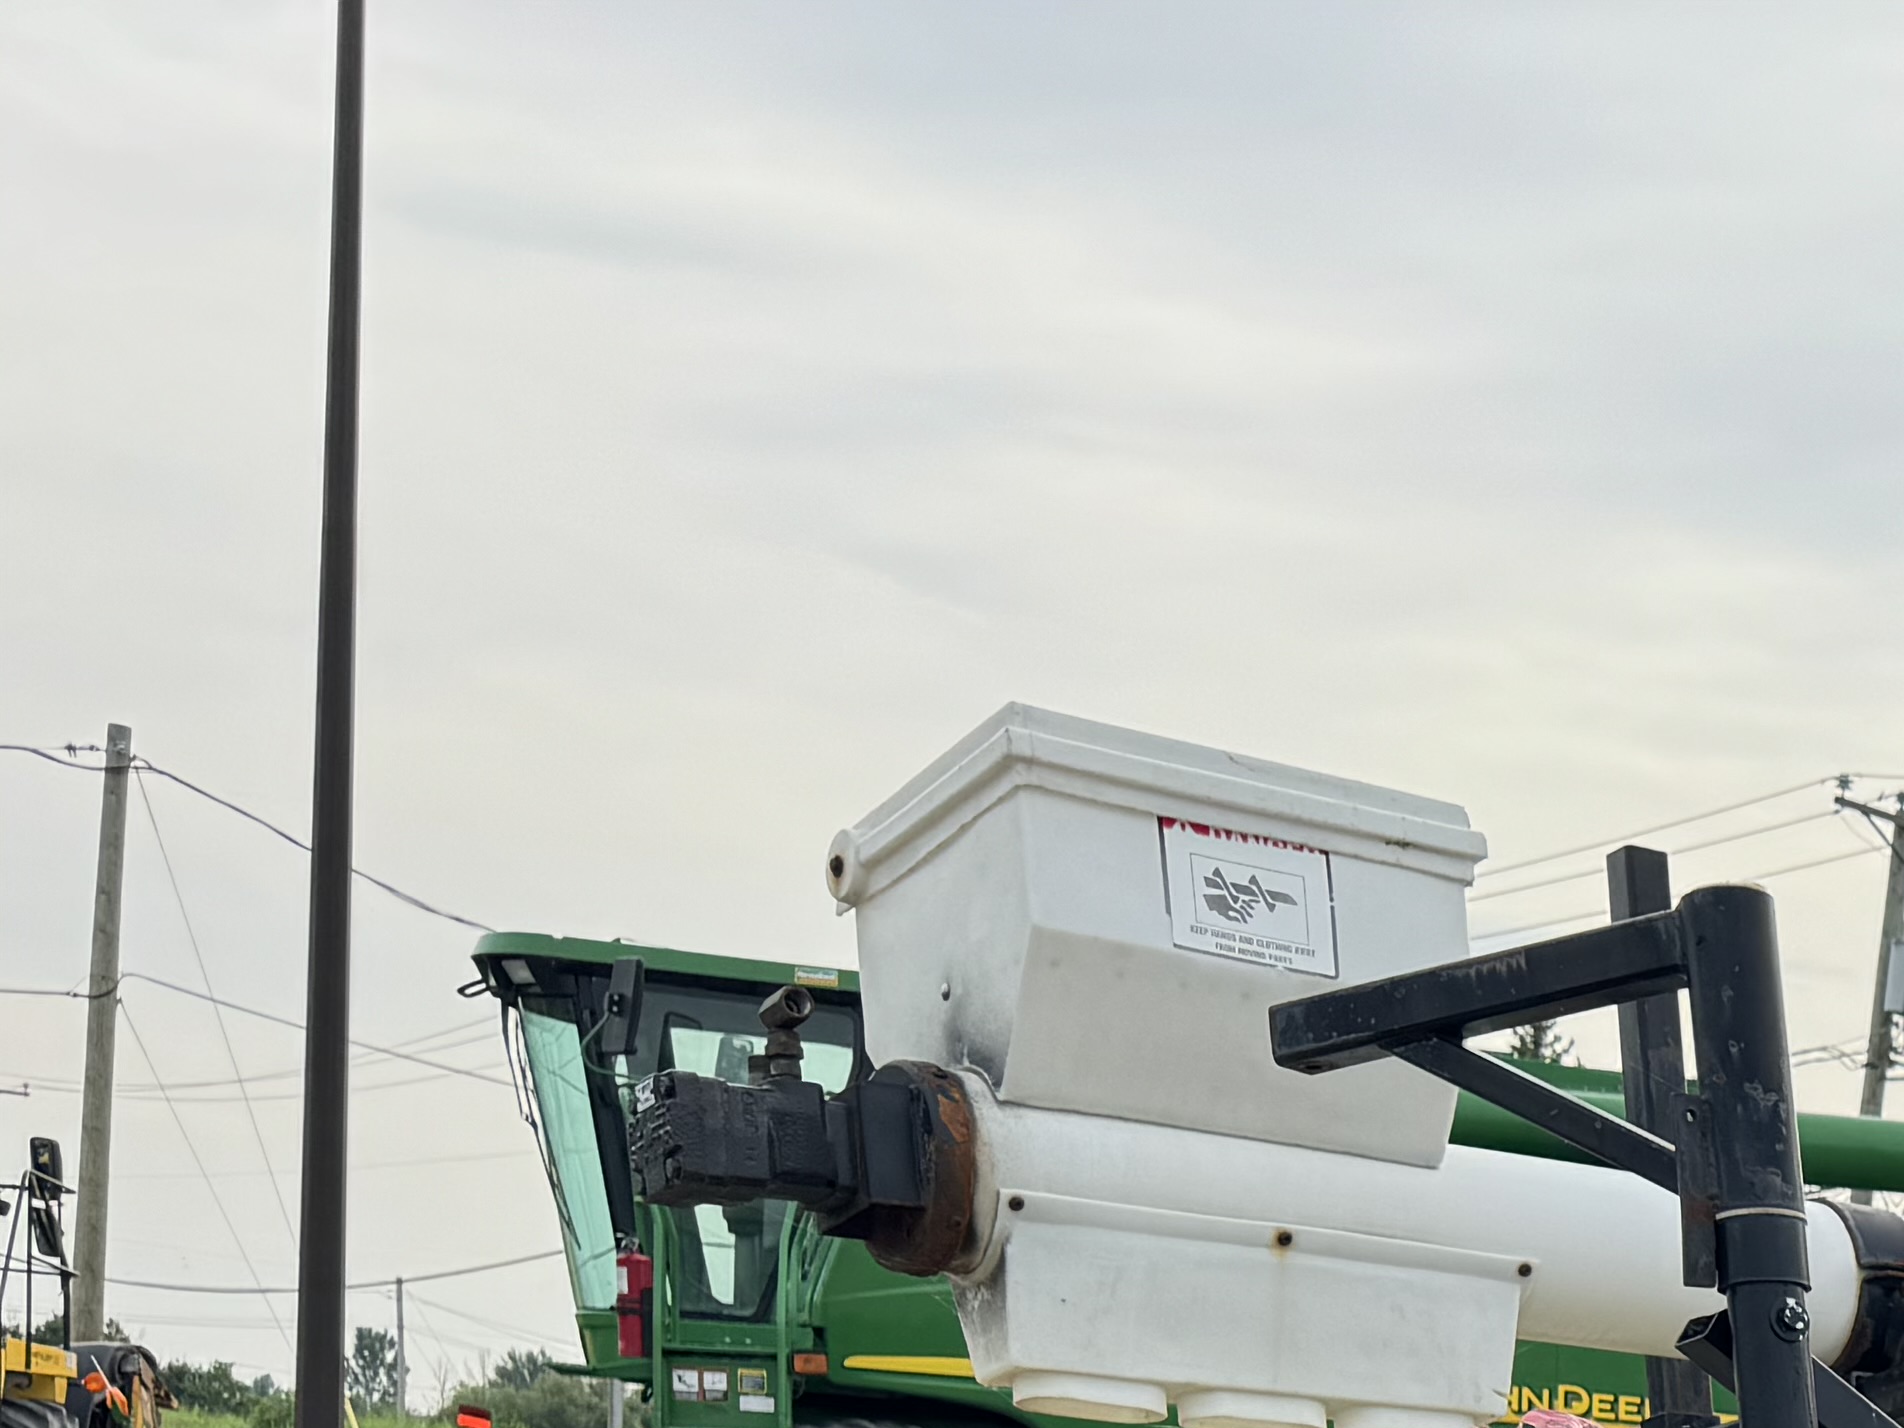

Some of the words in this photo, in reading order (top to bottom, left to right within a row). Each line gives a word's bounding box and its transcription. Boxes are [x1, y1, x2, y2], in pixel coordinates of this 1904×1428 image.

[1190, 924, 1208, 937] KEEP
[1238, 934, 1255, 946] AND
[1256, 938, 1293, 954] CLOTHING
